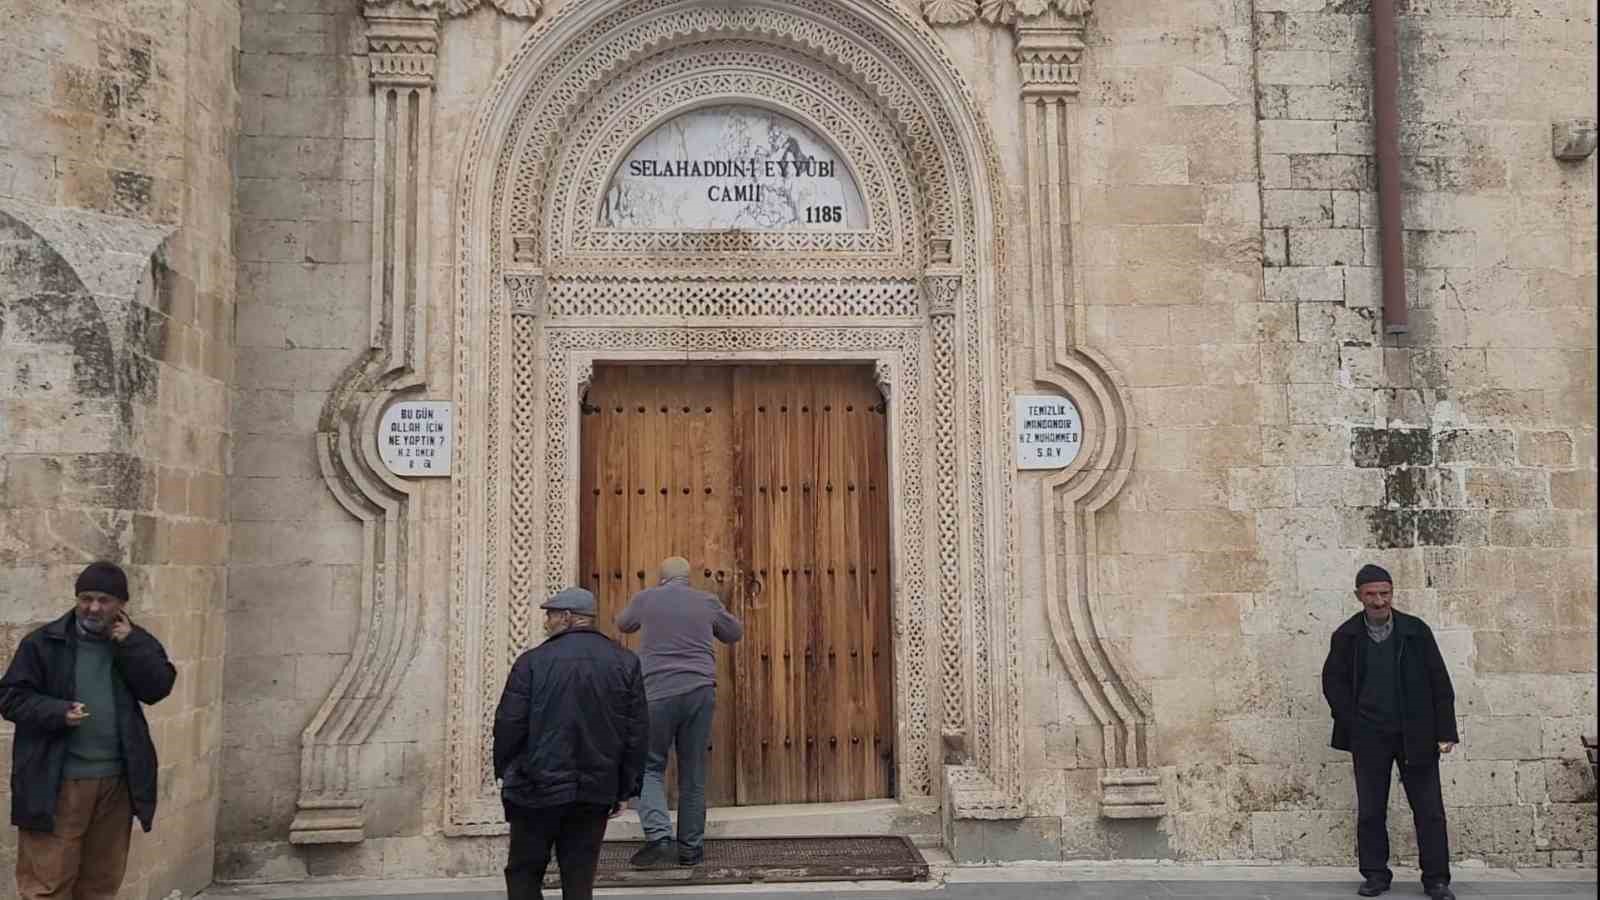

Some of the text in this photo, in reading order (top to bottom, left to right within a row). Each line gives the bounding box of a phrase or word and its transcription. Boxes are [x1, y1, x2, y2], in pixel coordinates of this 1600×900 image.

[707, 183, 761, 202] CAMİİ
[805, 206, 842, 223] 1185
[401, 407, 433, 419] BU GÜN
[391, 422, 420, 432] ALLAH
[389, 435, 400, 446] NE
